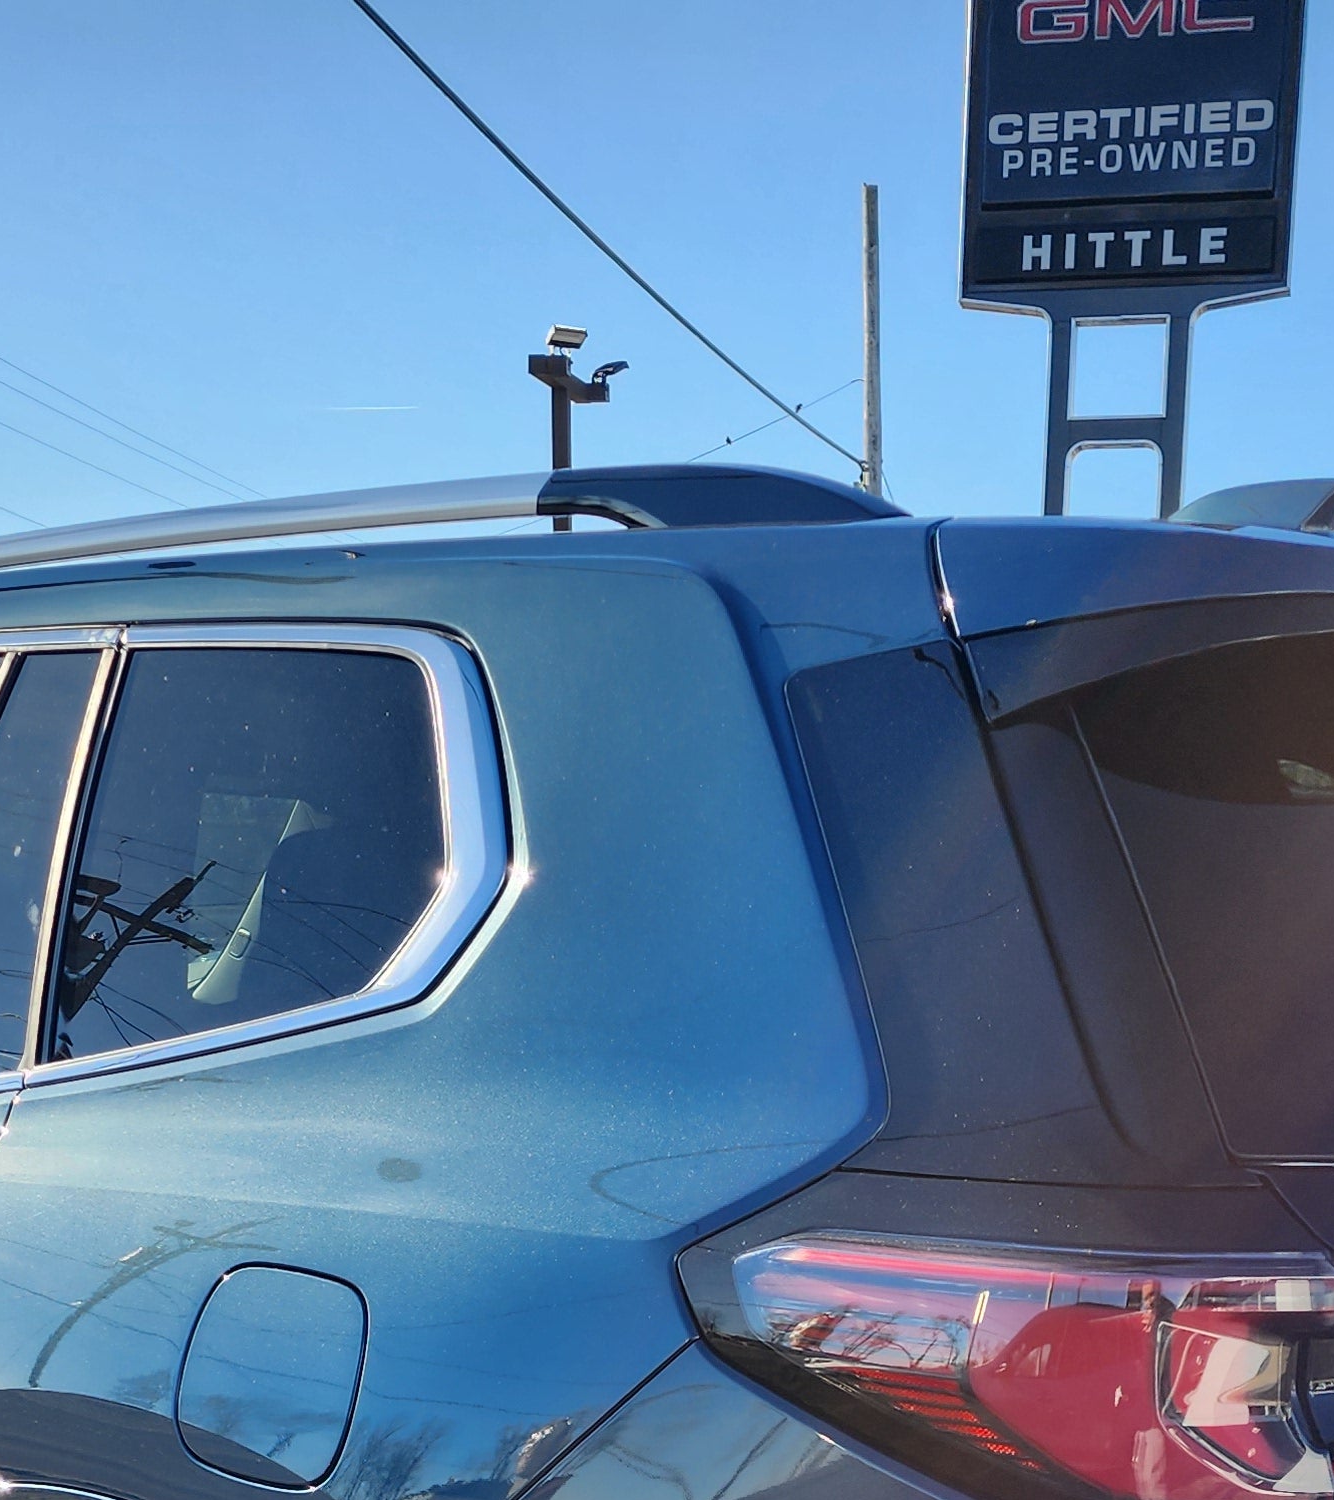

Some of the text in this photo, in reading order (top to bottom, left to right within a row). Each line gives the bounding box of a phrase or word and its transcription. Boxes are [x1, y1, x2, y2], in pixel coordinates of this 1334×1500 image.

[1017, 0, 1255, 44] GMC
[988, 99, 1275, 145] CERTIFIED
[1002, 136, 1256, 179] PRE-OWNED
[1021, 227, 1229, 271] HITTLE
